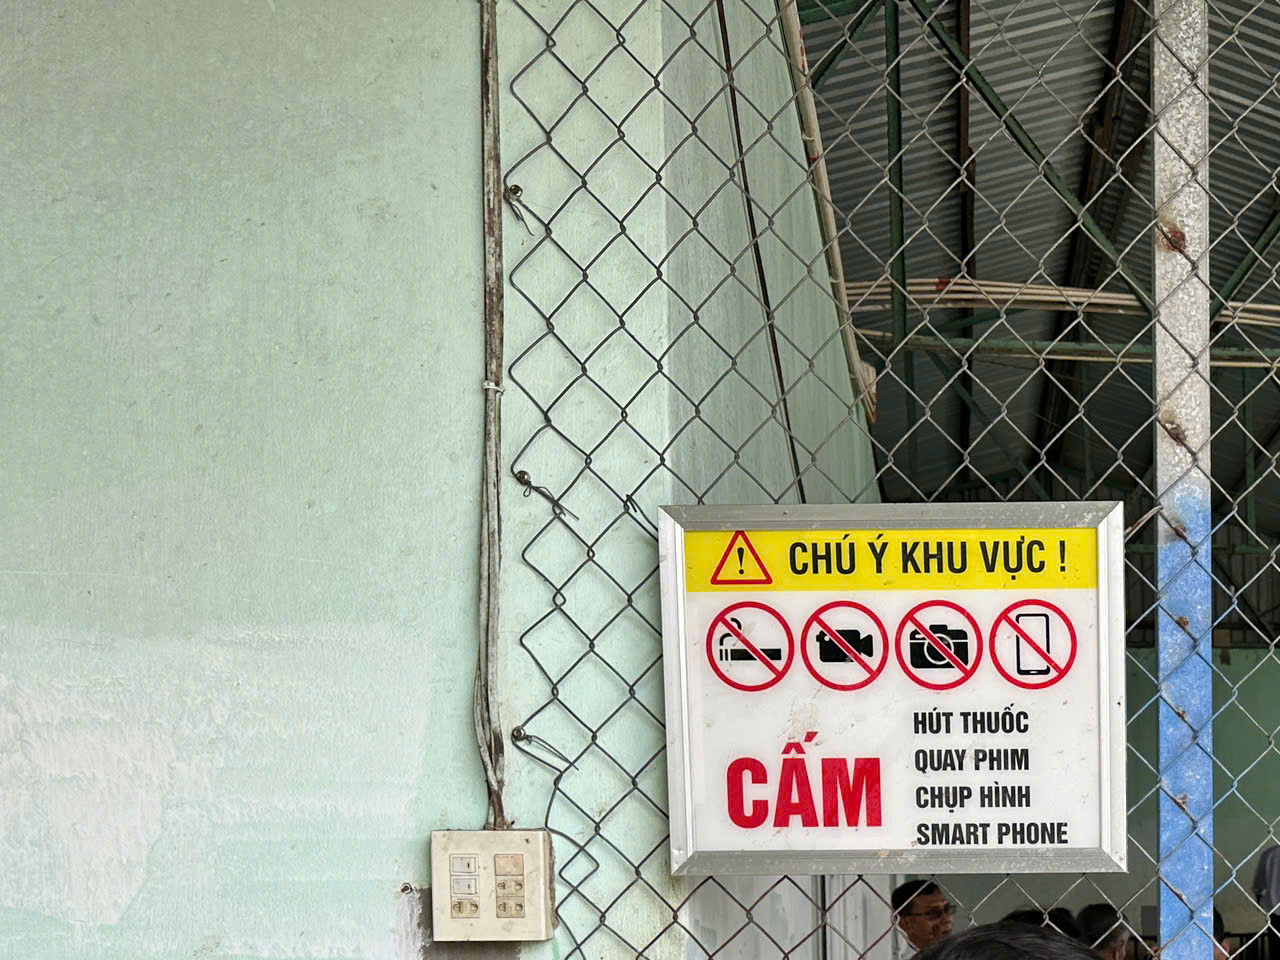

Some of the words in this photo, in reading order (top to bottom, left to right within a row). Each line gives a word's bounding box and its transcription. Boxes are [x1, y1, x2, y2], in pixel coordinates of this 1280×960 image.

[789, 533, 856, 575] CHÚ
[868, 533, 889, 574] Ý
[901, 541, 968, 574] KHU
[979, 535, 1046, 581] VỰC
[1059, 540, 1067, 572] !
[913, 707, 954, 735] HÚT
[959, 703, 1029, 734] THUỐC
[914, 749, 967, 774] QUAY
[974, 748, 1030, 771] PHIM
[726, 731, 883, 829] CẤM
[915, 786, 973, 813] CHỤP
[979, 781, 1031, 808] HÌNH
[916, 823, 990, 846] SMART
[997, 822, 1069, 845] PHONE
